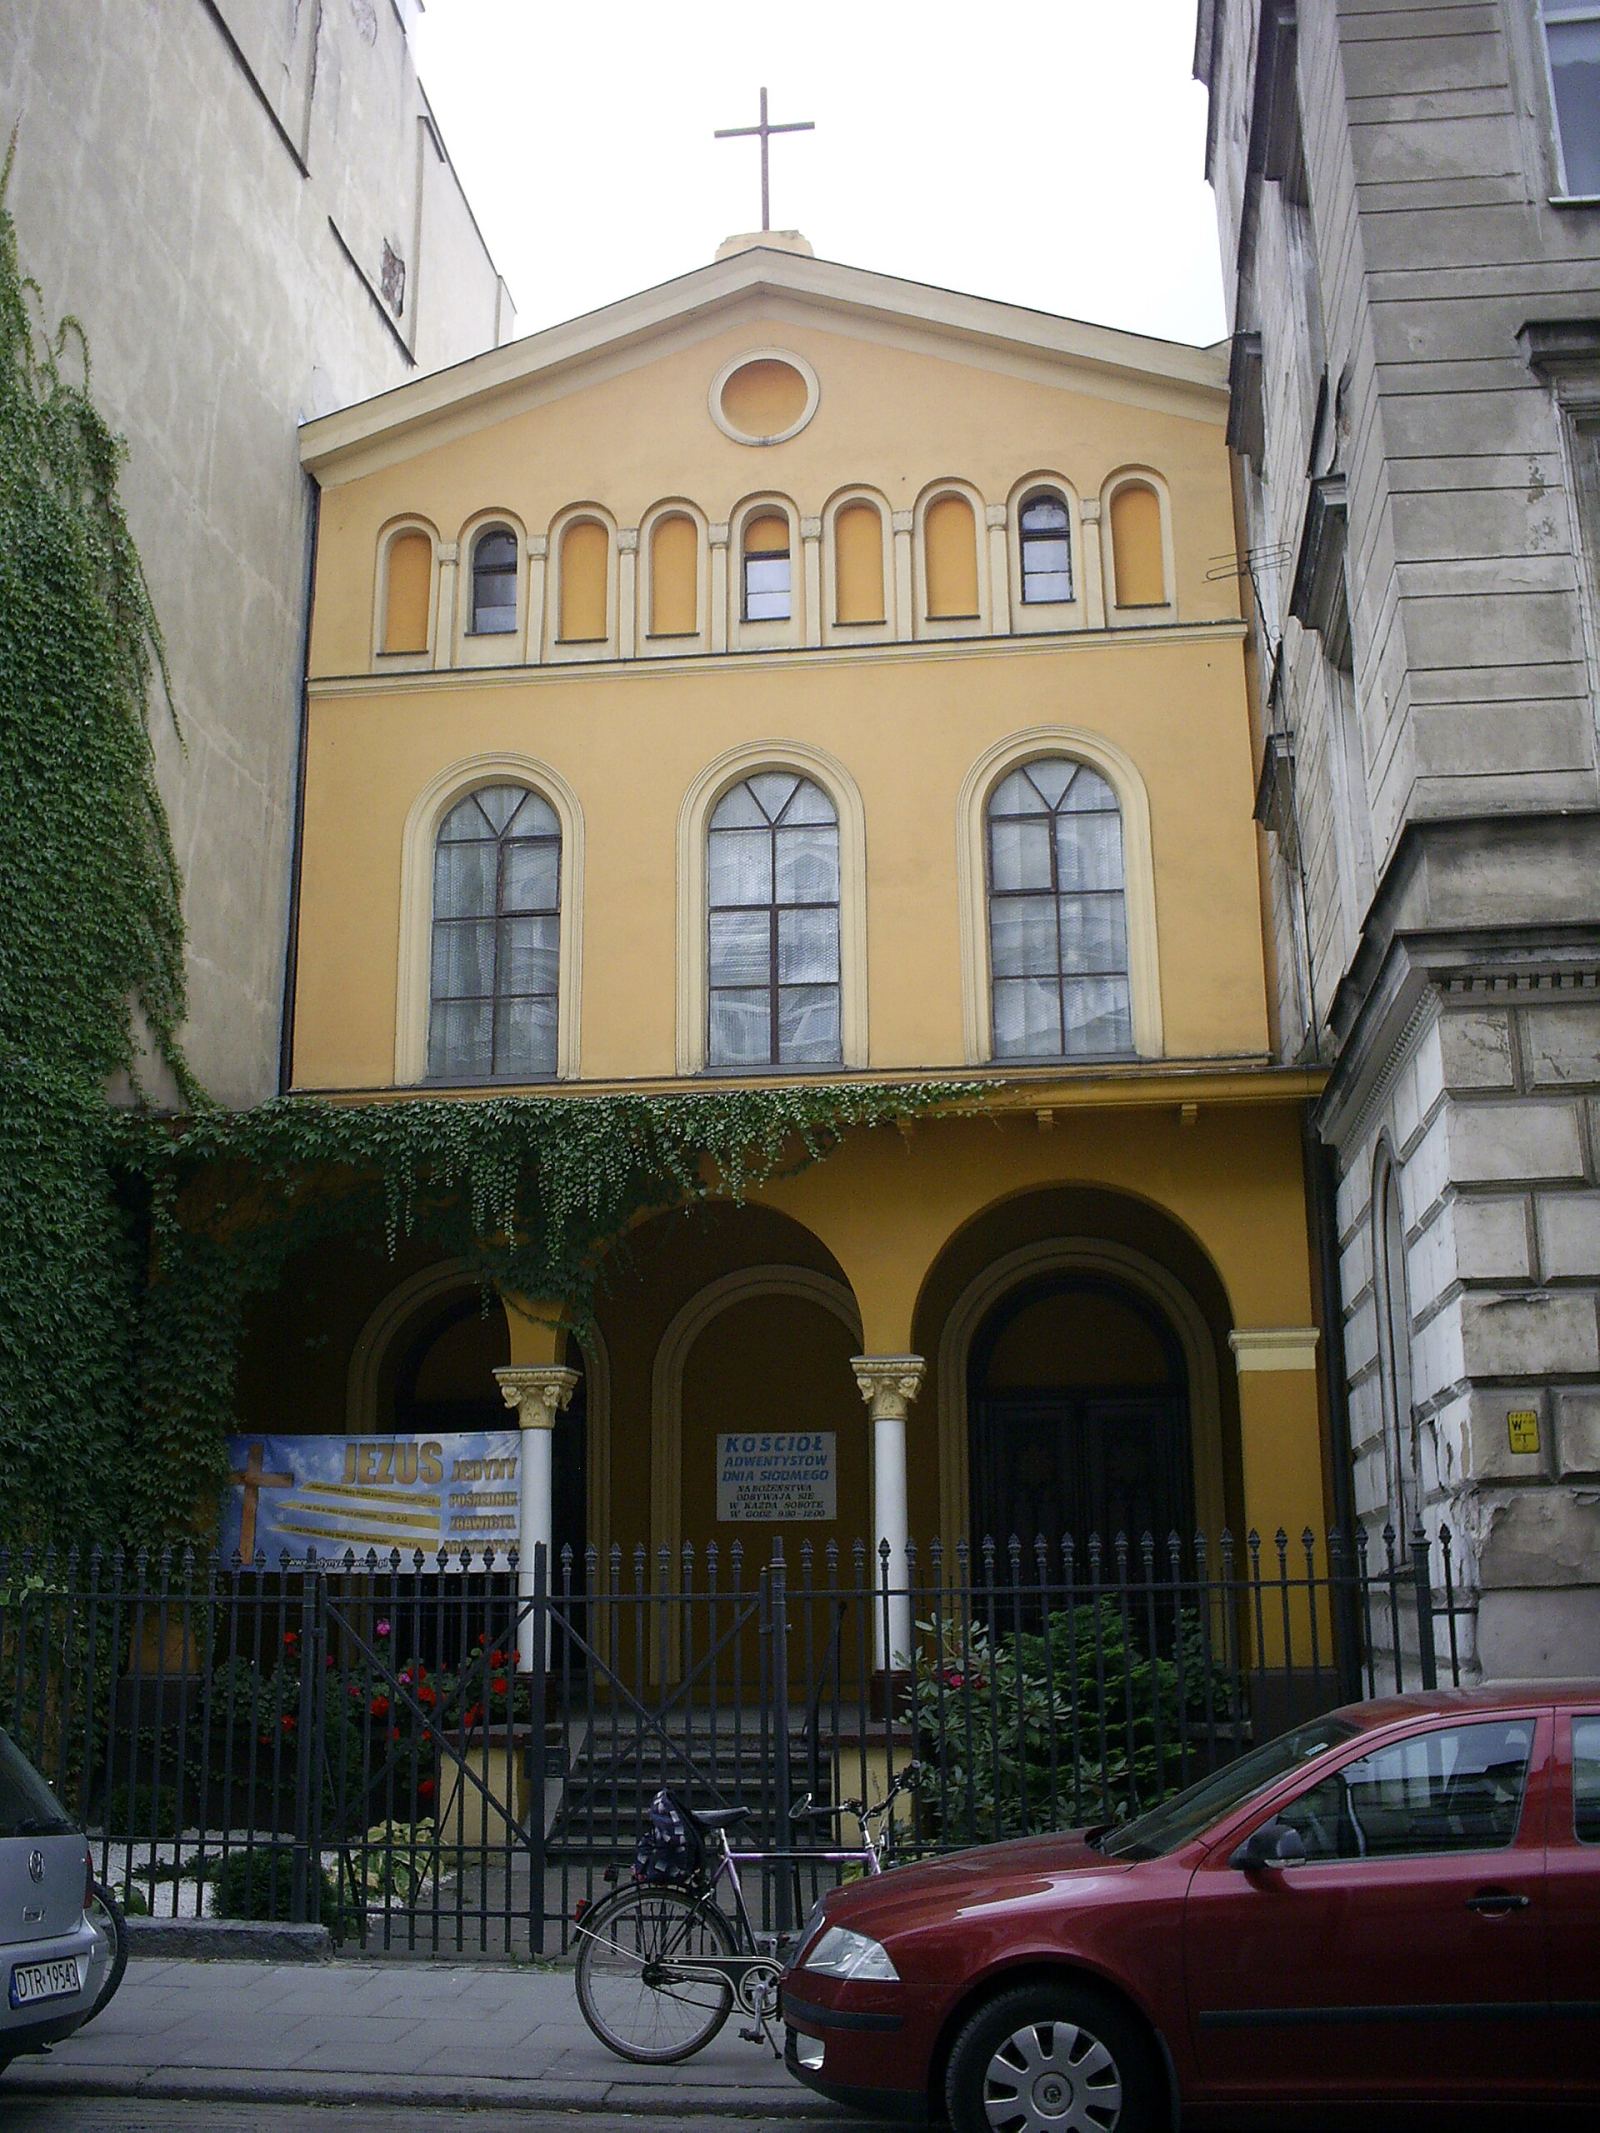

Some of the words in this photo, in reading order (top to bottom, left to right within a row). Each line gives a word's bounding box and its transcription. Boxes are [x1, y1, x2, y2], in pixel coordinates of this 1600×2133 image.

[341, 1441, 444, 1485] JEZUS
[722, 1470, 754, 1482] DNIA
[17, 1968, 44, 1998] DTR
[46, 1963, 77, 1991] 19543
